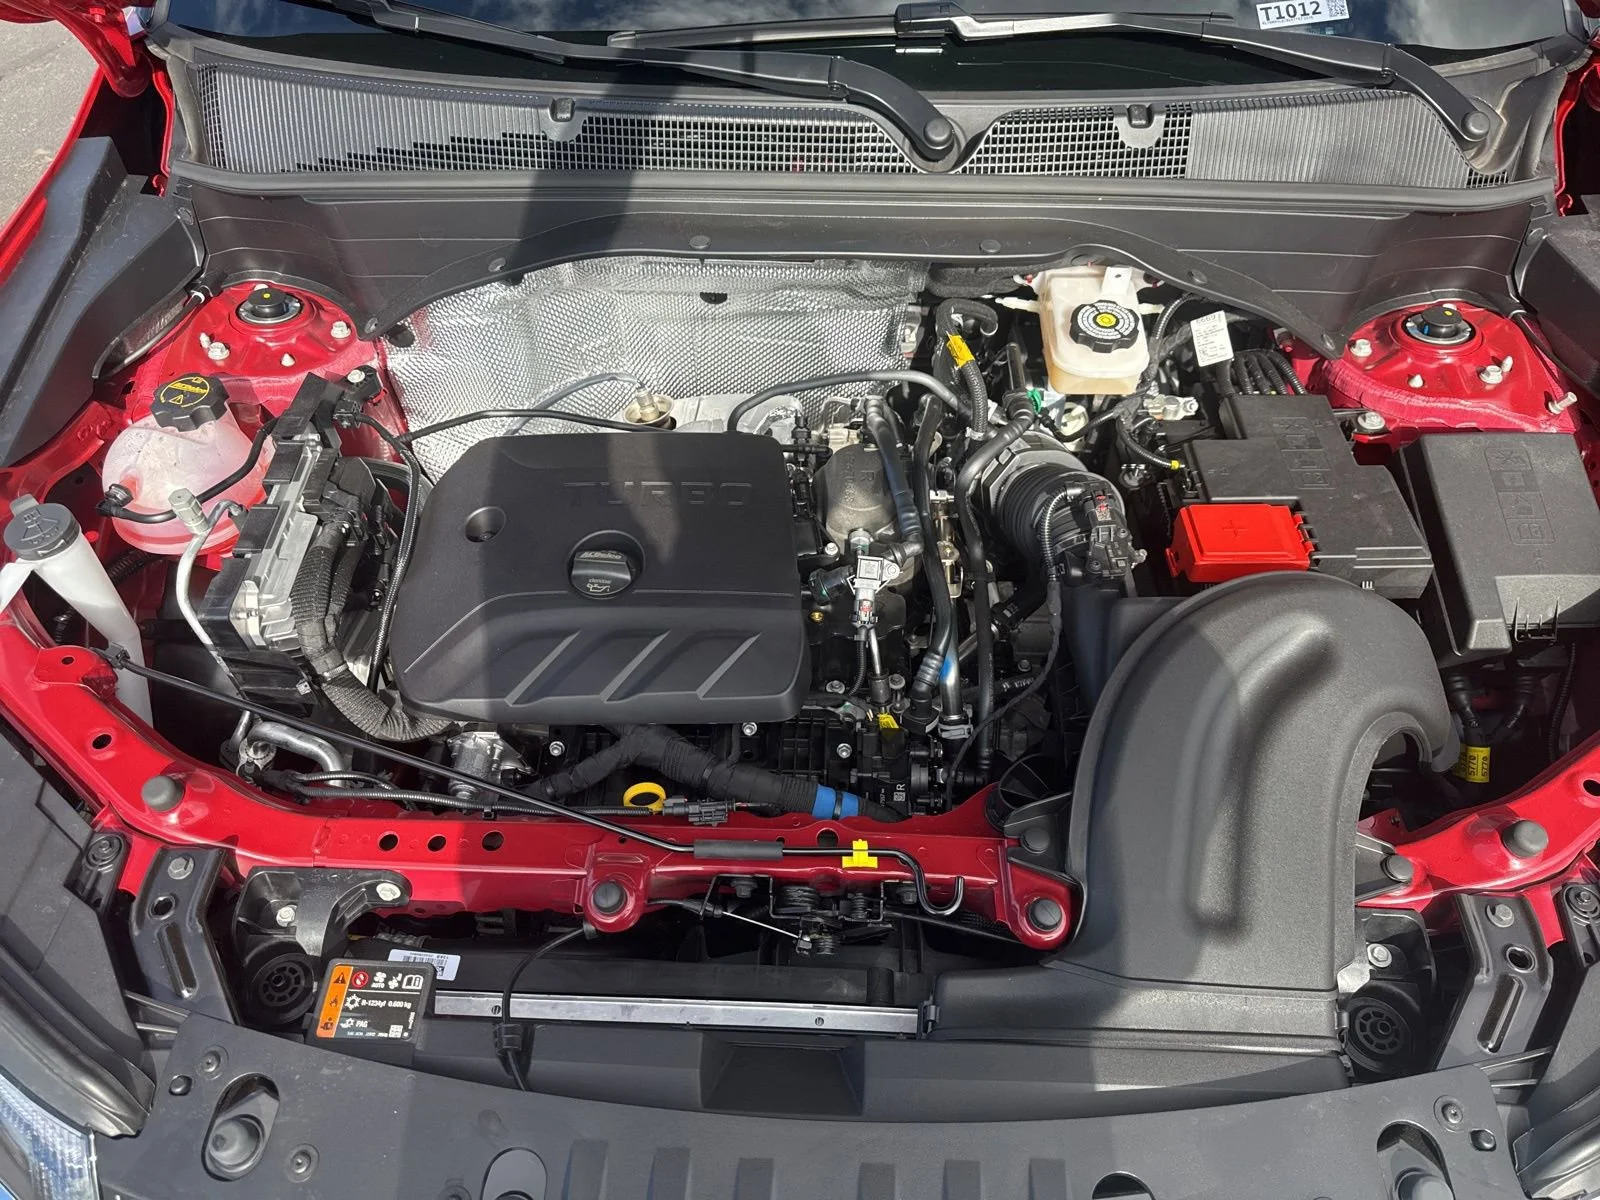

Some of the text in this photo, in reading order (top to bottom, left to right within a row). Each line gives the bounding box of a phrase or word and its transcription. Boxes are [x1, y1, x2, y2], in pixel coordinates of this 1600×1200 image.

[1260, 1, 1322, 21] T1012
[563, 480, 752, 506] TURBO
[580, 551, 622, 559] ACDelco
[356, 1020, 368, 1028] PAG
